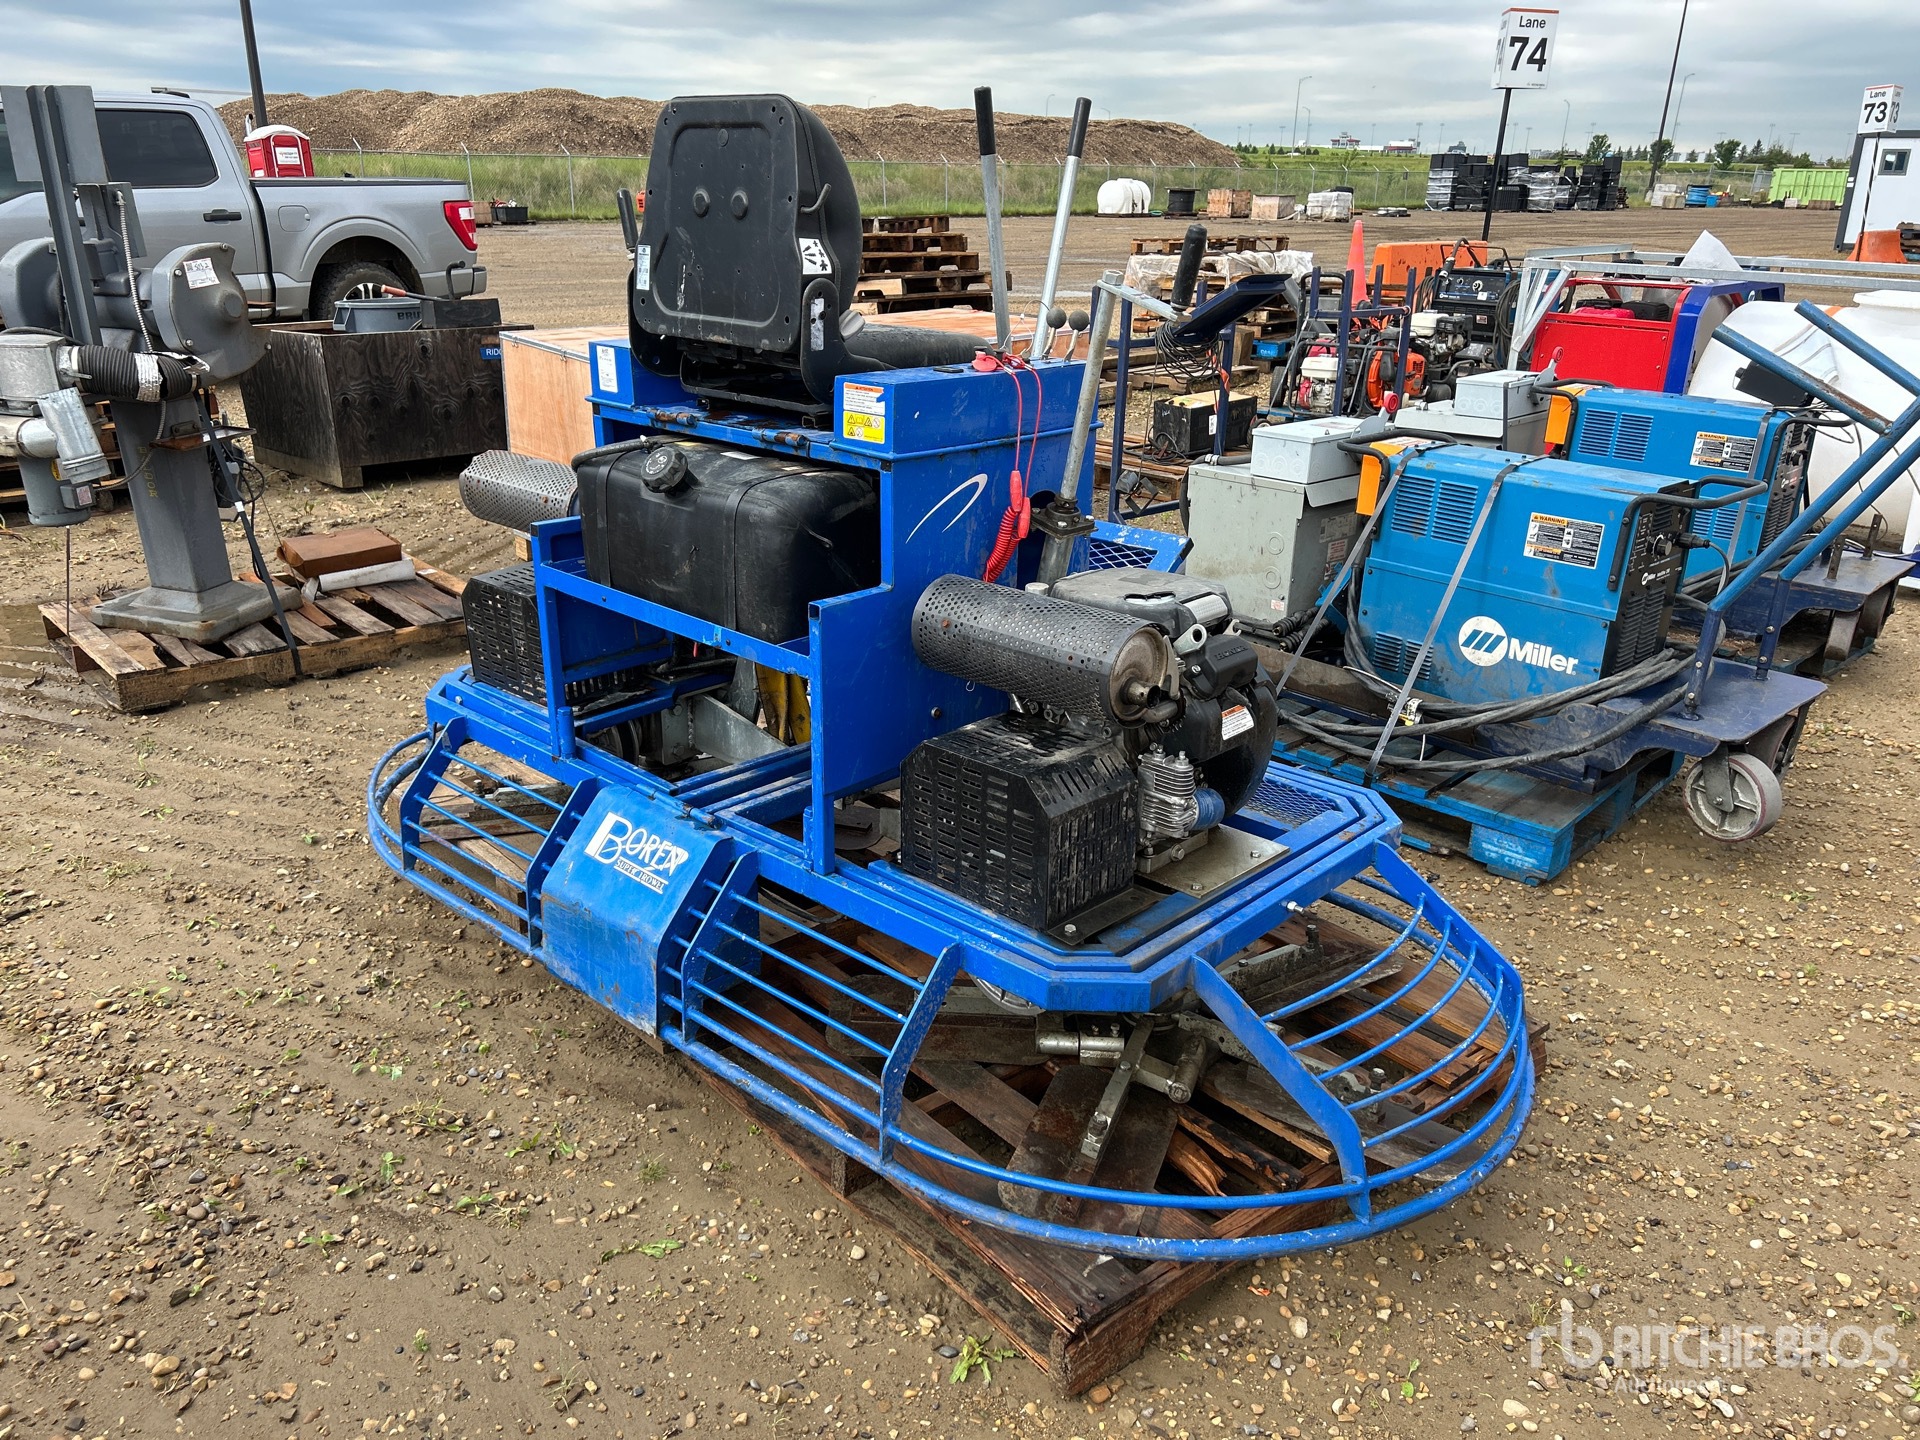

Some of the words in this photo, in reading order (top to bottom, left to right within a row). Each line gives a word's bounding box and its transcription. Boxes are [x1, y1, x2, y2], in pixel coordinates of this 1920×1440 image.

[1519, 15, 1547, 29] Lane
[1508, 36, 1548, 72] 74
[1869, 90, 1887, 99] Lane
[1864, 101, 1888, 124] 73
[1889, 100, 1900, 124] 73
[1539, 515, 1565, 525] WARNING
[1213, 645, 1248, 661] HONDA
[1508, 637, 1579, 676] Miller
[585, 812, 688, 876] BOREN
[615, 859, 638, 878] SUPER
[638, 871, 667, 892] TROWEL
